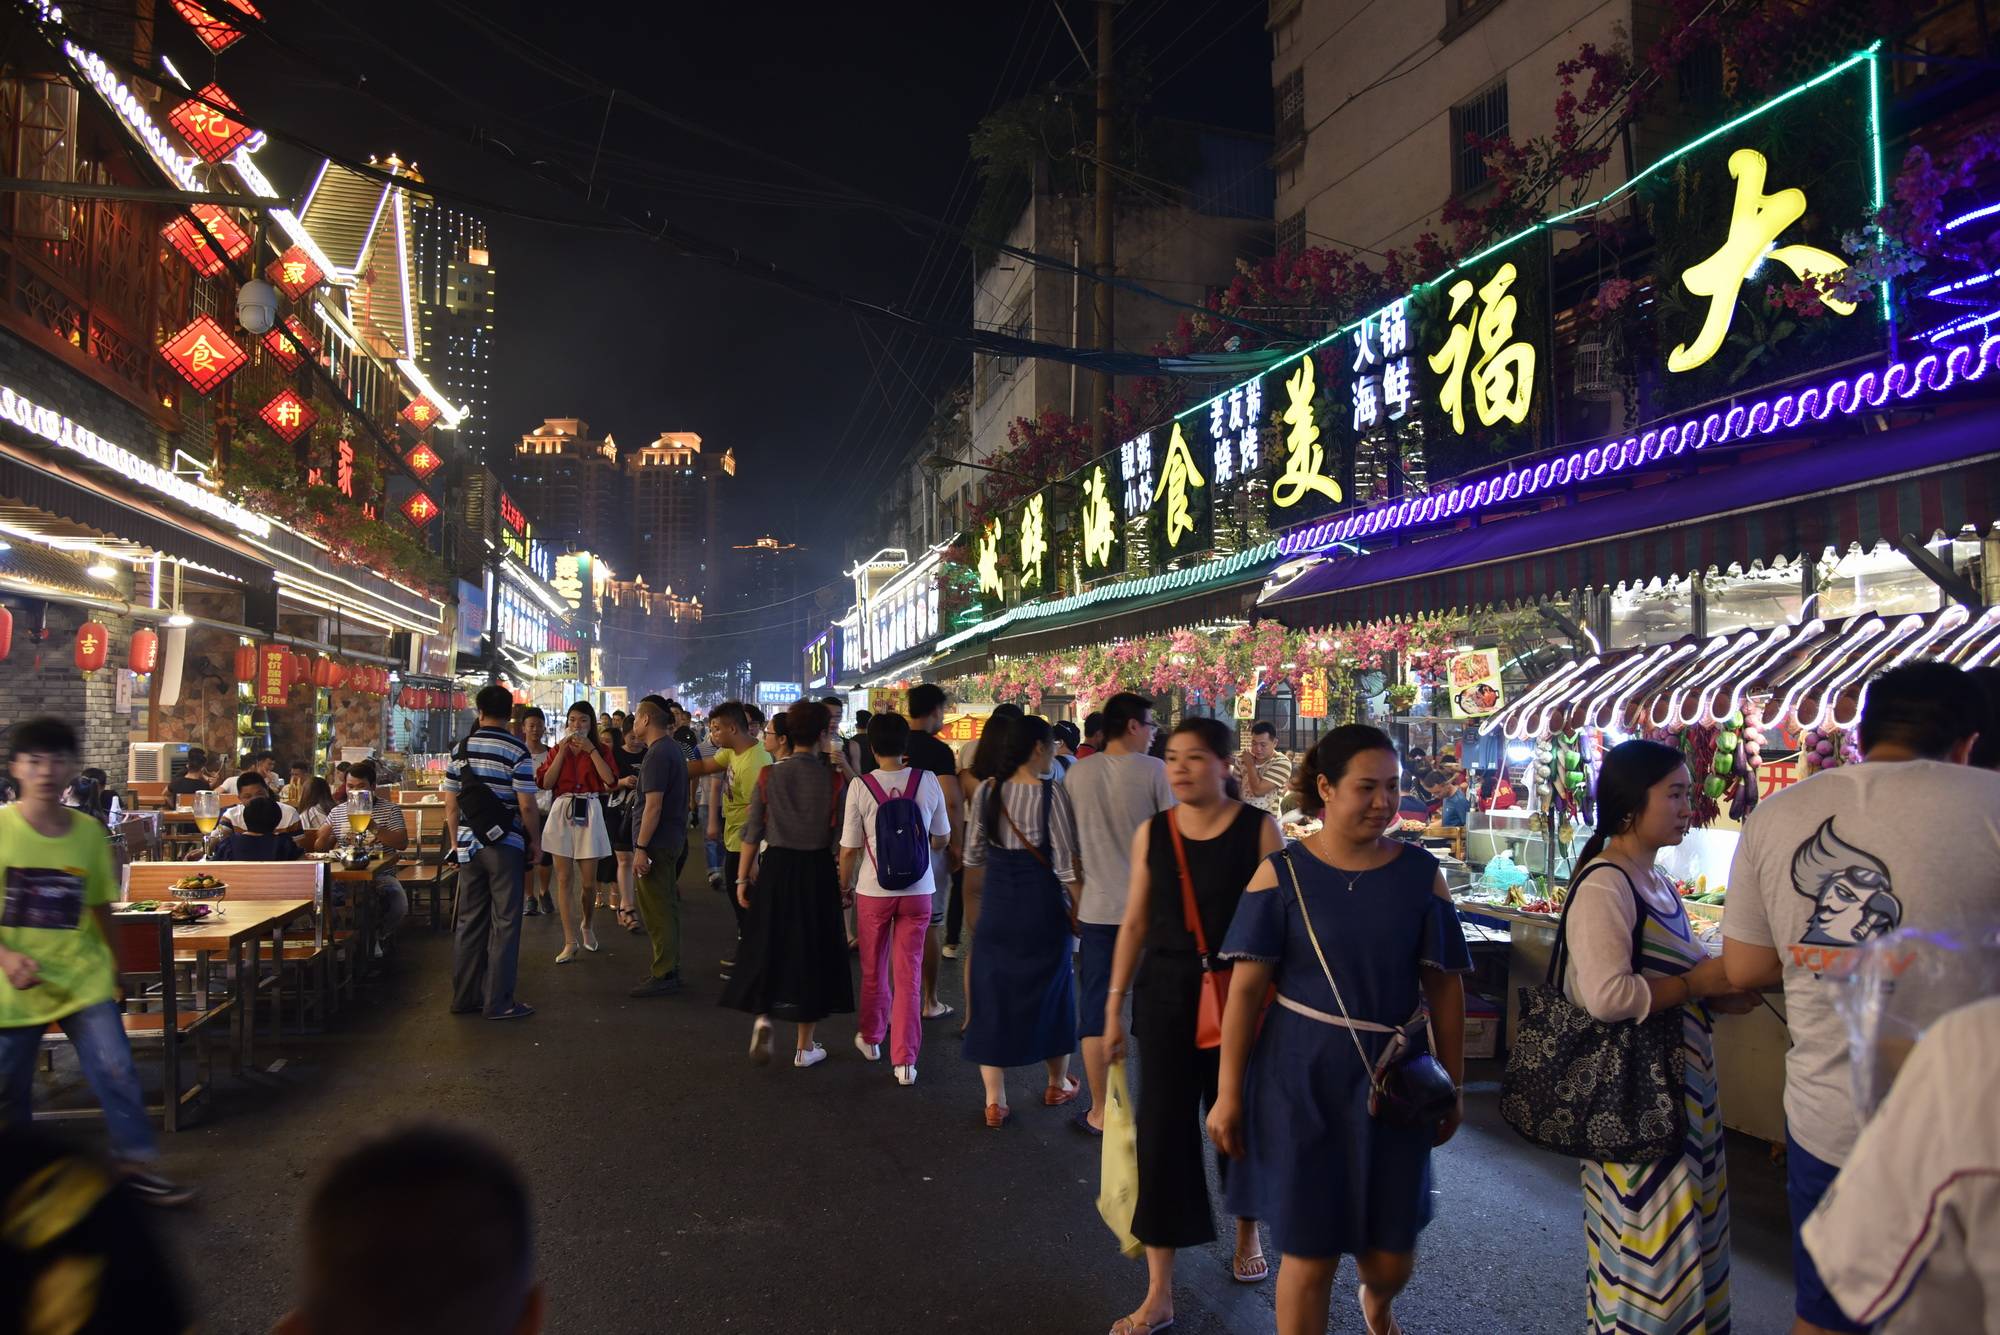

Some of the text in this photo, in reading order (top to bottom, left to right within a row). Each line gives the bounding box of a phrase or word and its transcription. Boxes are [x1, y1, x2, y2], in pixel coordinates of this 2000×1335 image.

[283, 263, 307, 284] 家
[1667, 148, 1858, 373] 大
[182, 335, 225, 372] 食
[1352, 297, 1408, 373] 火锅
[1428, 263, 1536, 436] 福
[276, 401, 302, 427] 村
[1210, 377, 1262, 439] 老友粉
[1272, 355, 1343, 508] 美
[1352, 358, 1412, 432] 海鲜
[410, 405, 431, 518] 家 味 村
[1154, 422, 1206, 547] 食
[1214, 425, 1258, 484] 烧烤
[1083, 466, 1115, 568] 海
[1124, 471, 1154, 517] 小炒
[80, 633, 99, 654] 吉
